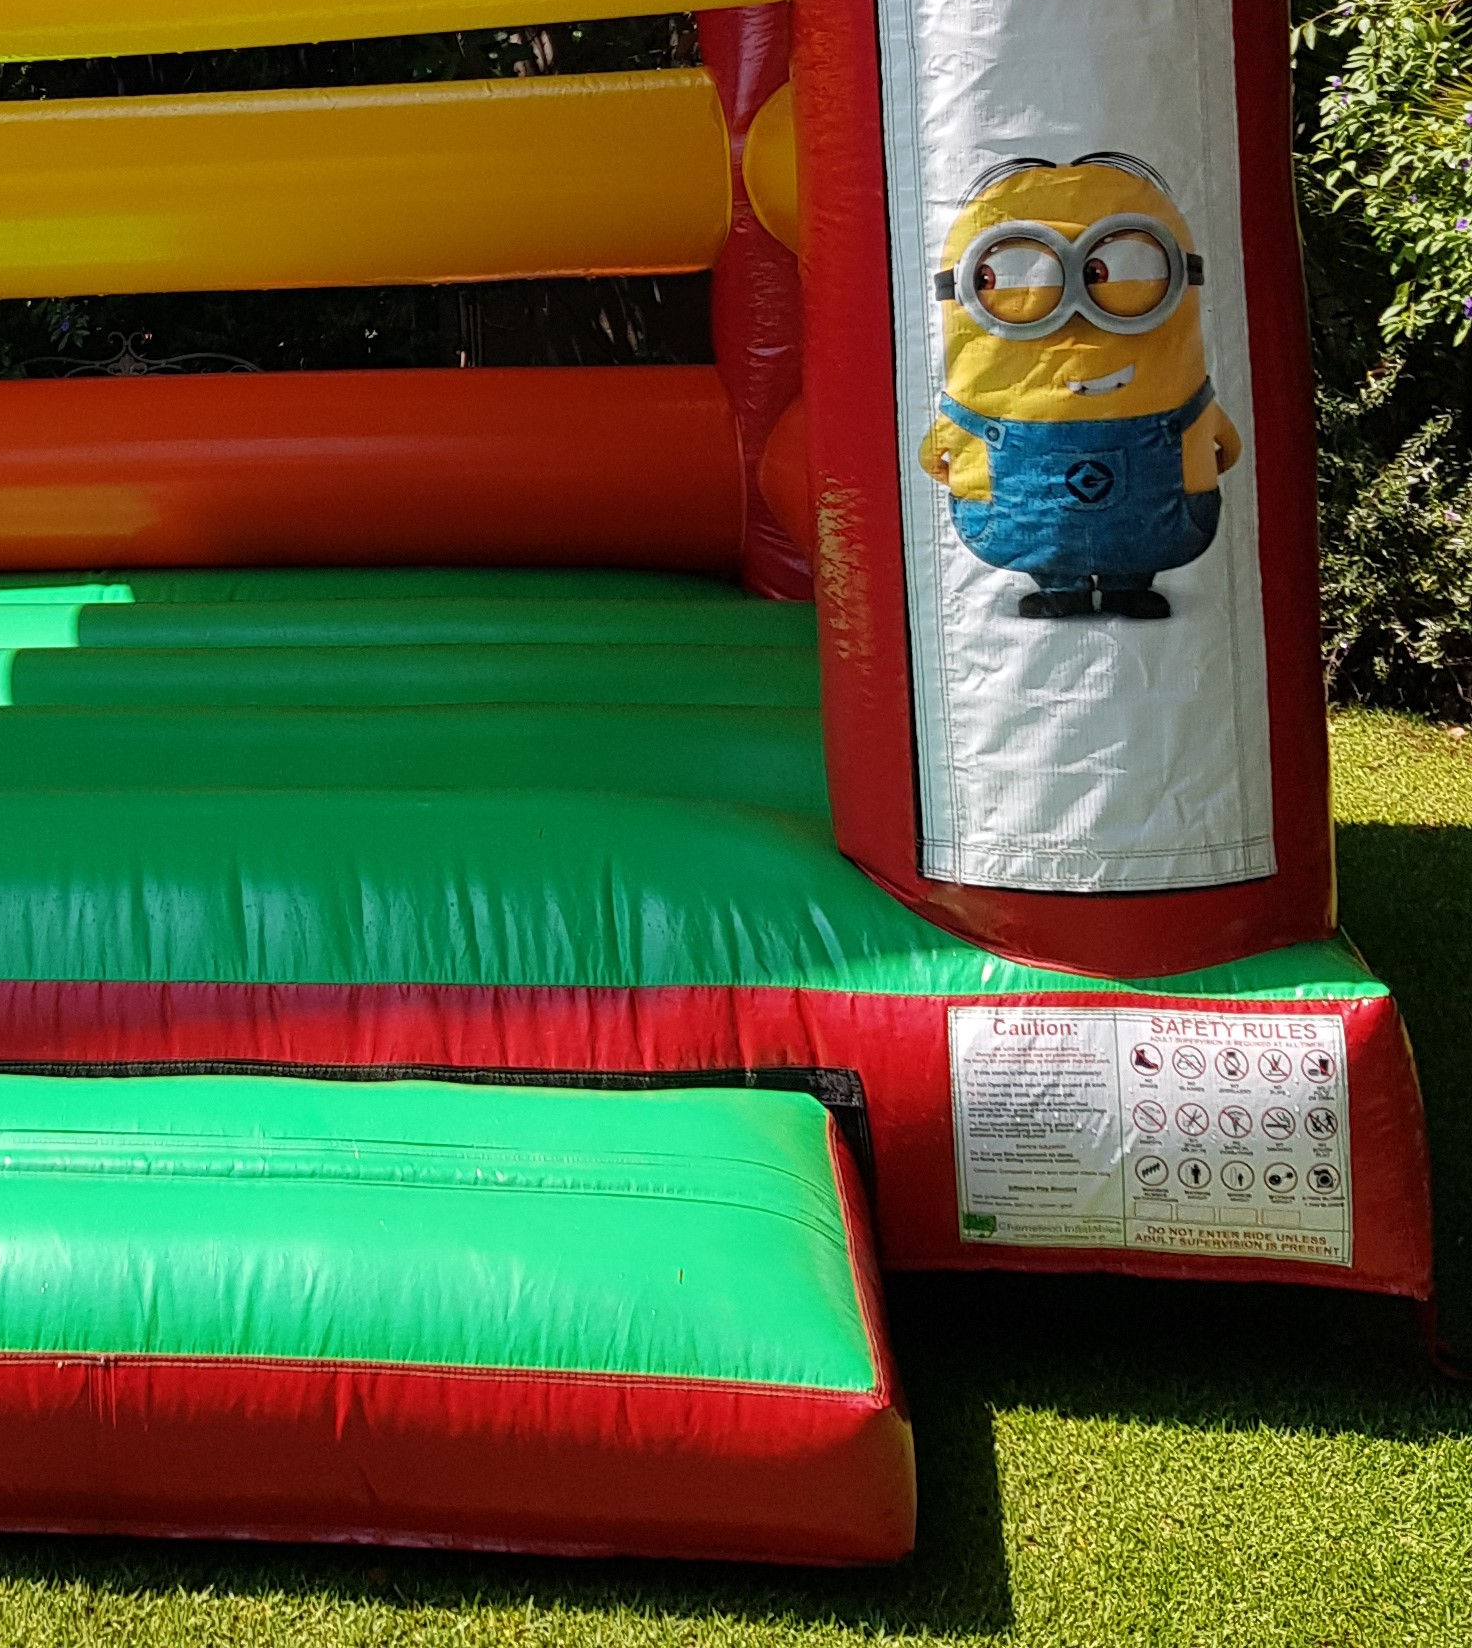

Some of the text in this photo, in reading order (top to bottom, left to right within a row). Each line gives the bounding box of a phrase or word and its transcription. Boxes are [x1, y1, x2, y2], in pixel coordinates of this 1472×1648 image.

[993, 1018, 1078, 1036] Caution:
[1151, 1017, 1318, 1040] SAFETY RULES
[1134, 1233, 1340, 1256] ADULT SUPERVISION IS PRESENT
[1147, 1225, 1327, 1246] DO NOT ENTER RIDE UNLESS
